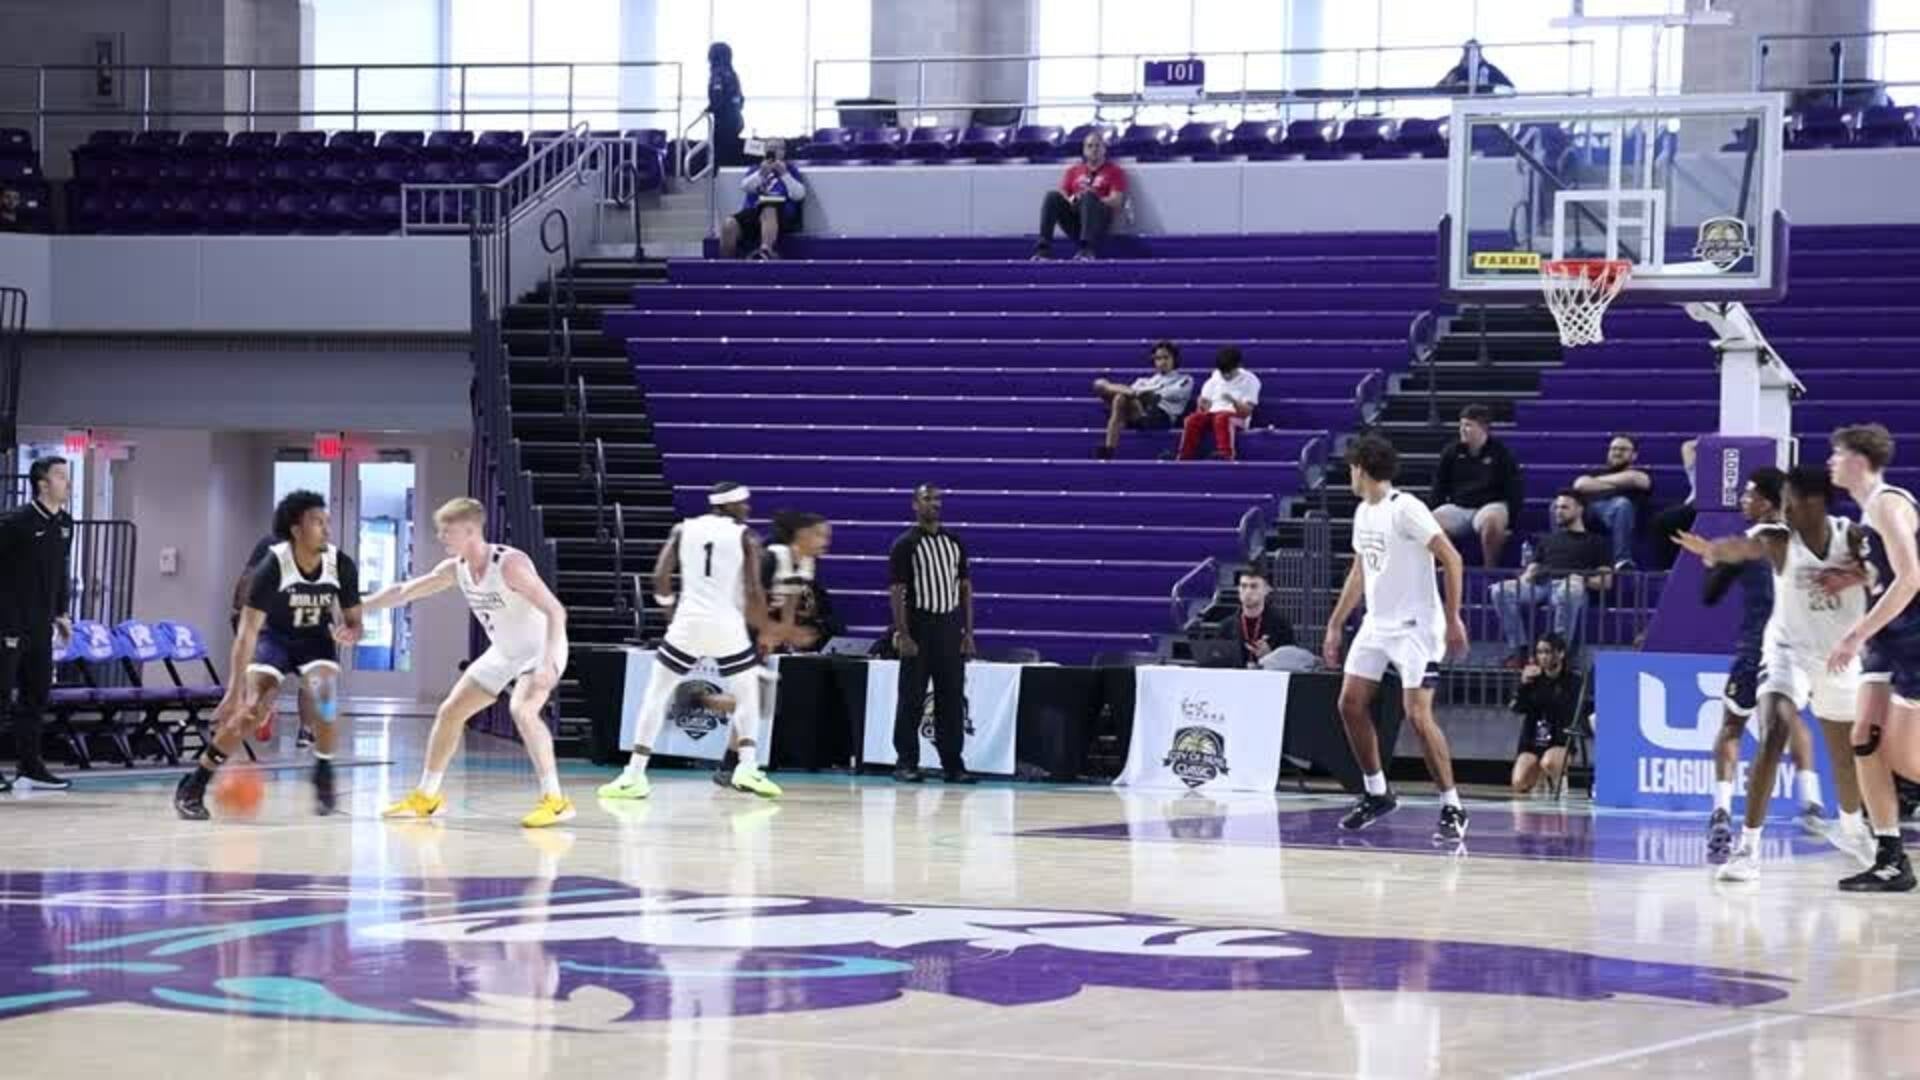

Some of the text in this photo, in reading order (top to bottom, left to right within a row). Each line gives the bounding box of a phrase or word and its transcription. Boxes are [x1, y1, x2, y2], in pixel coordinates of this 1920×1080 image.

[1167, 63, 1194, 81] 101
[1478, 255, 1537, 266] PANINI
[703, 541, 713, 577] 1
[293, 607, 321, 627] 13
